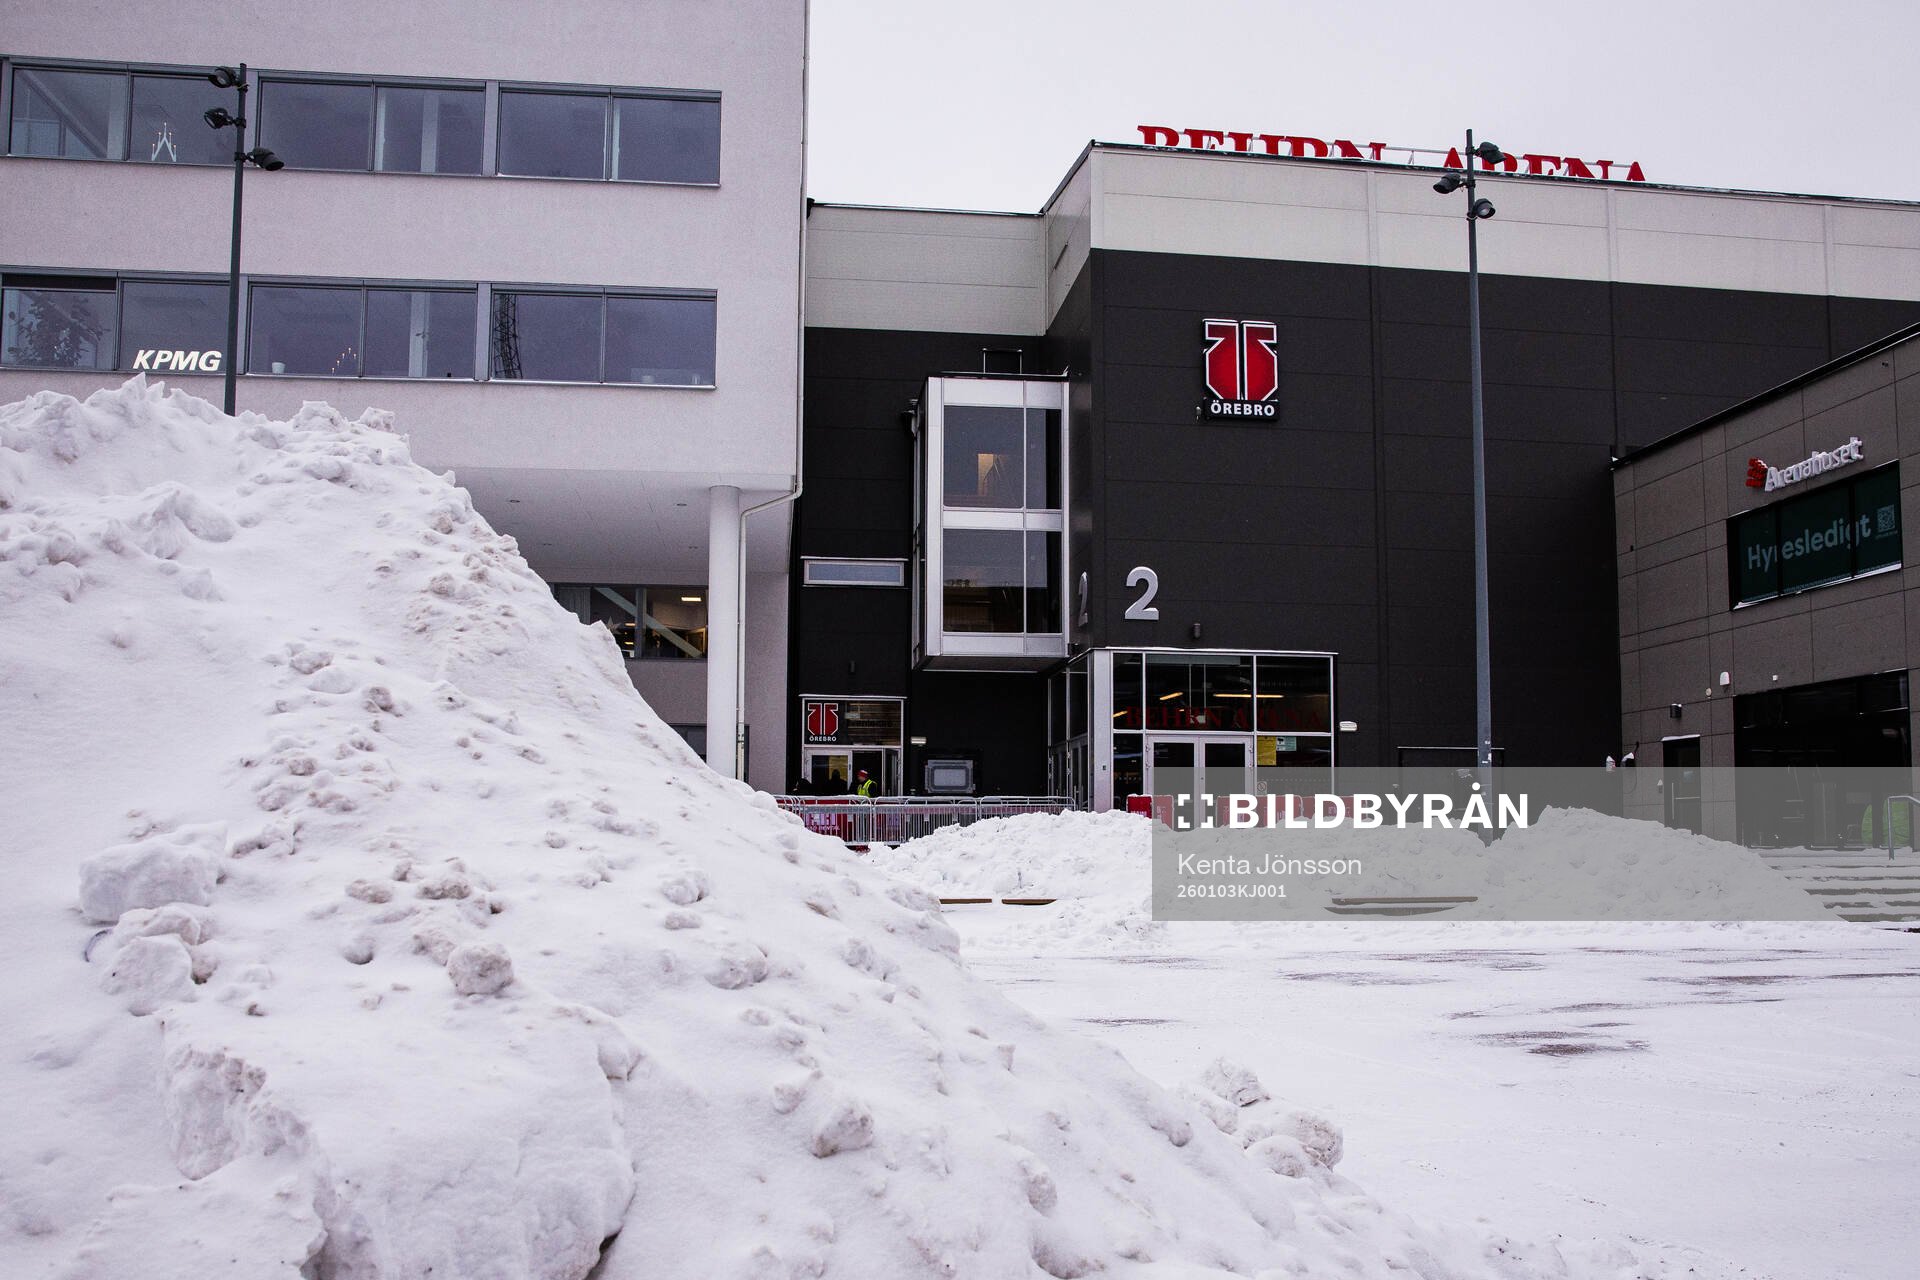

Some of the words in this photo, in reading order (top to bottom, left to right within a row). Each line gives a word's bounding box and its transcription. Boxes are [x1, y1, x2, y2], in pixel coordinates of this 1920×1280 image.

[132, 349, 222, 371] KPMG
[1210, 399, 1275, 416] ÖREBRO
[1764, 436, 1864, 492] Arenahuset
[1124, 566, 1160, 620] 2
